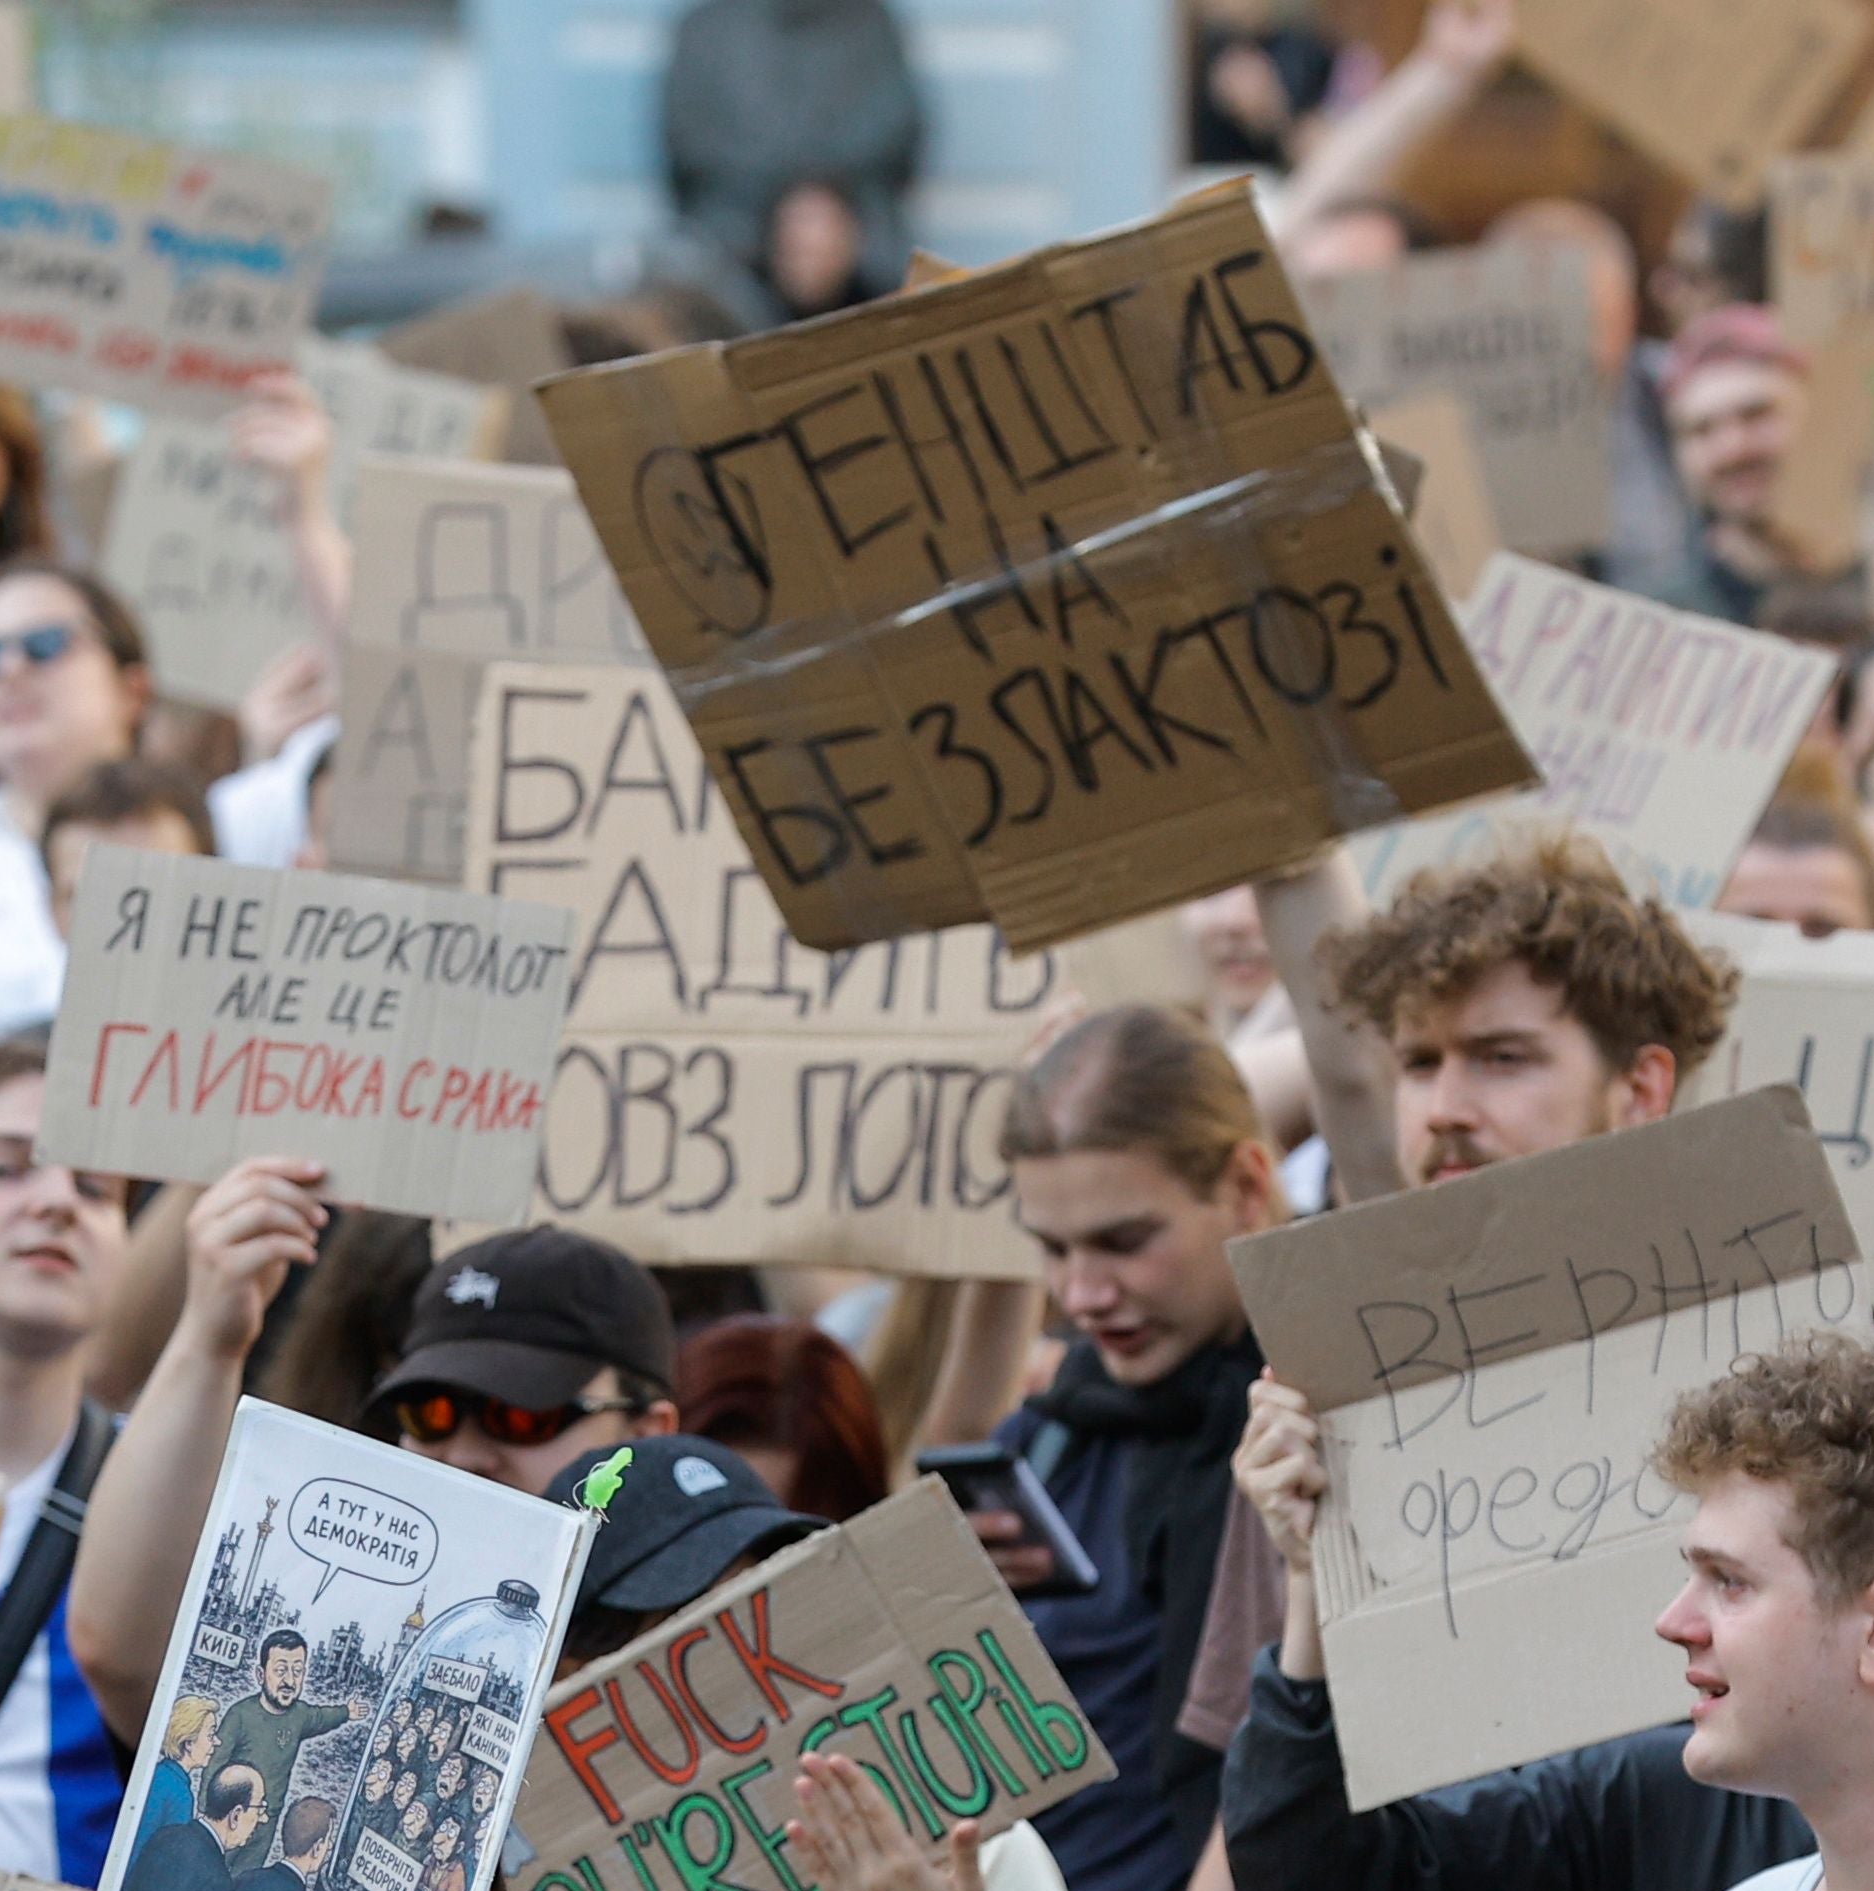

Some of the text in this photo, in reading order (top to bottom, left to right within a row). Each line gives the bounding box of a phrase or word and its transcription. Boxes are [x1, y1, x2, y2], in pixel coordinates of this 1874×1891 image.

[696, 250, 1318, 592] ГЕНШТАБ
[926, 502, 1138, 662] НА
[104, 886, 152, 952] Я
[178, 894, 262, 964] НЕ
[216, 972, 404, 1032] АЛЕ ЦЕ
[88, 1022, 388, 1120] ГЛИБОКА
[302, 1514, 420, 1570] ДЕМОКРАТІЯ
[317, 1492, 421, 1540] А ТУТ У НАС
[198, 1631, 241, 1661] КИЇВ
[426, 1661, 481, 1694] ЗАЄБАЛО
[544, 1586, 846, 1826] FUCK
